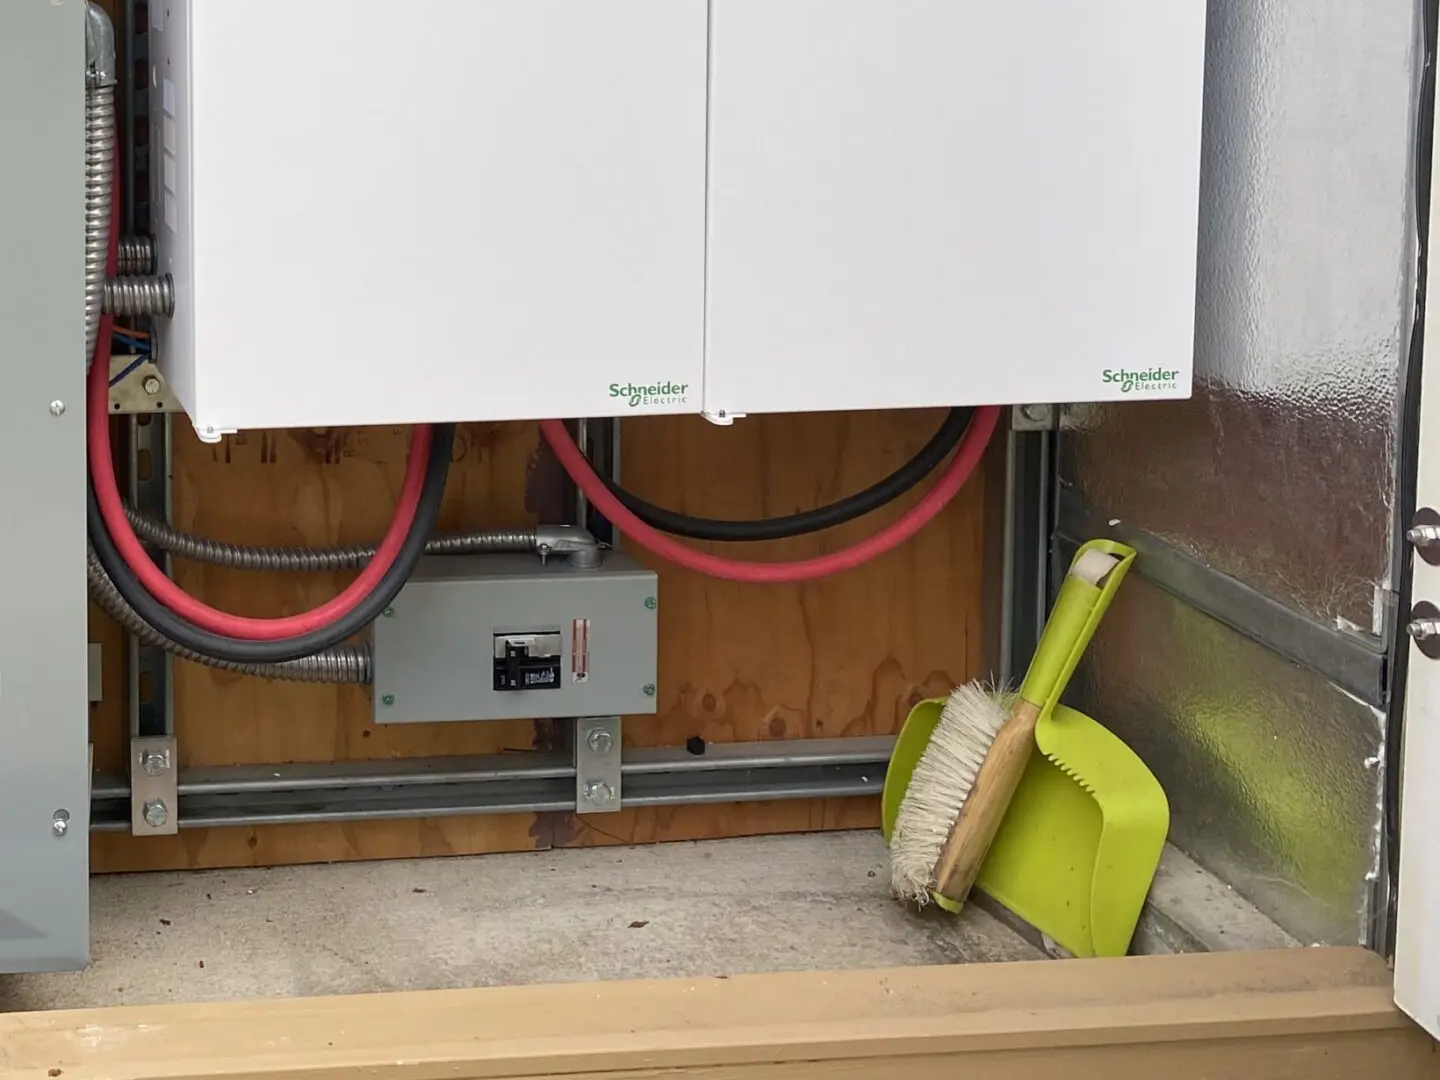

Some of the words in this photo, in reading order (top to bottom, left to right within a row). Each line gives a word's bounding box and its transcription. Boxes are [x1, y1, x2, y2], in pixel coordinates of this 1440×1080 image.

[1102, 368, 1179, 382] Schneider
[610, 382, 688, 396] Schneider
[1135, 382, 1176, 390] Electric
[644, 396, 687, 404] Electric
